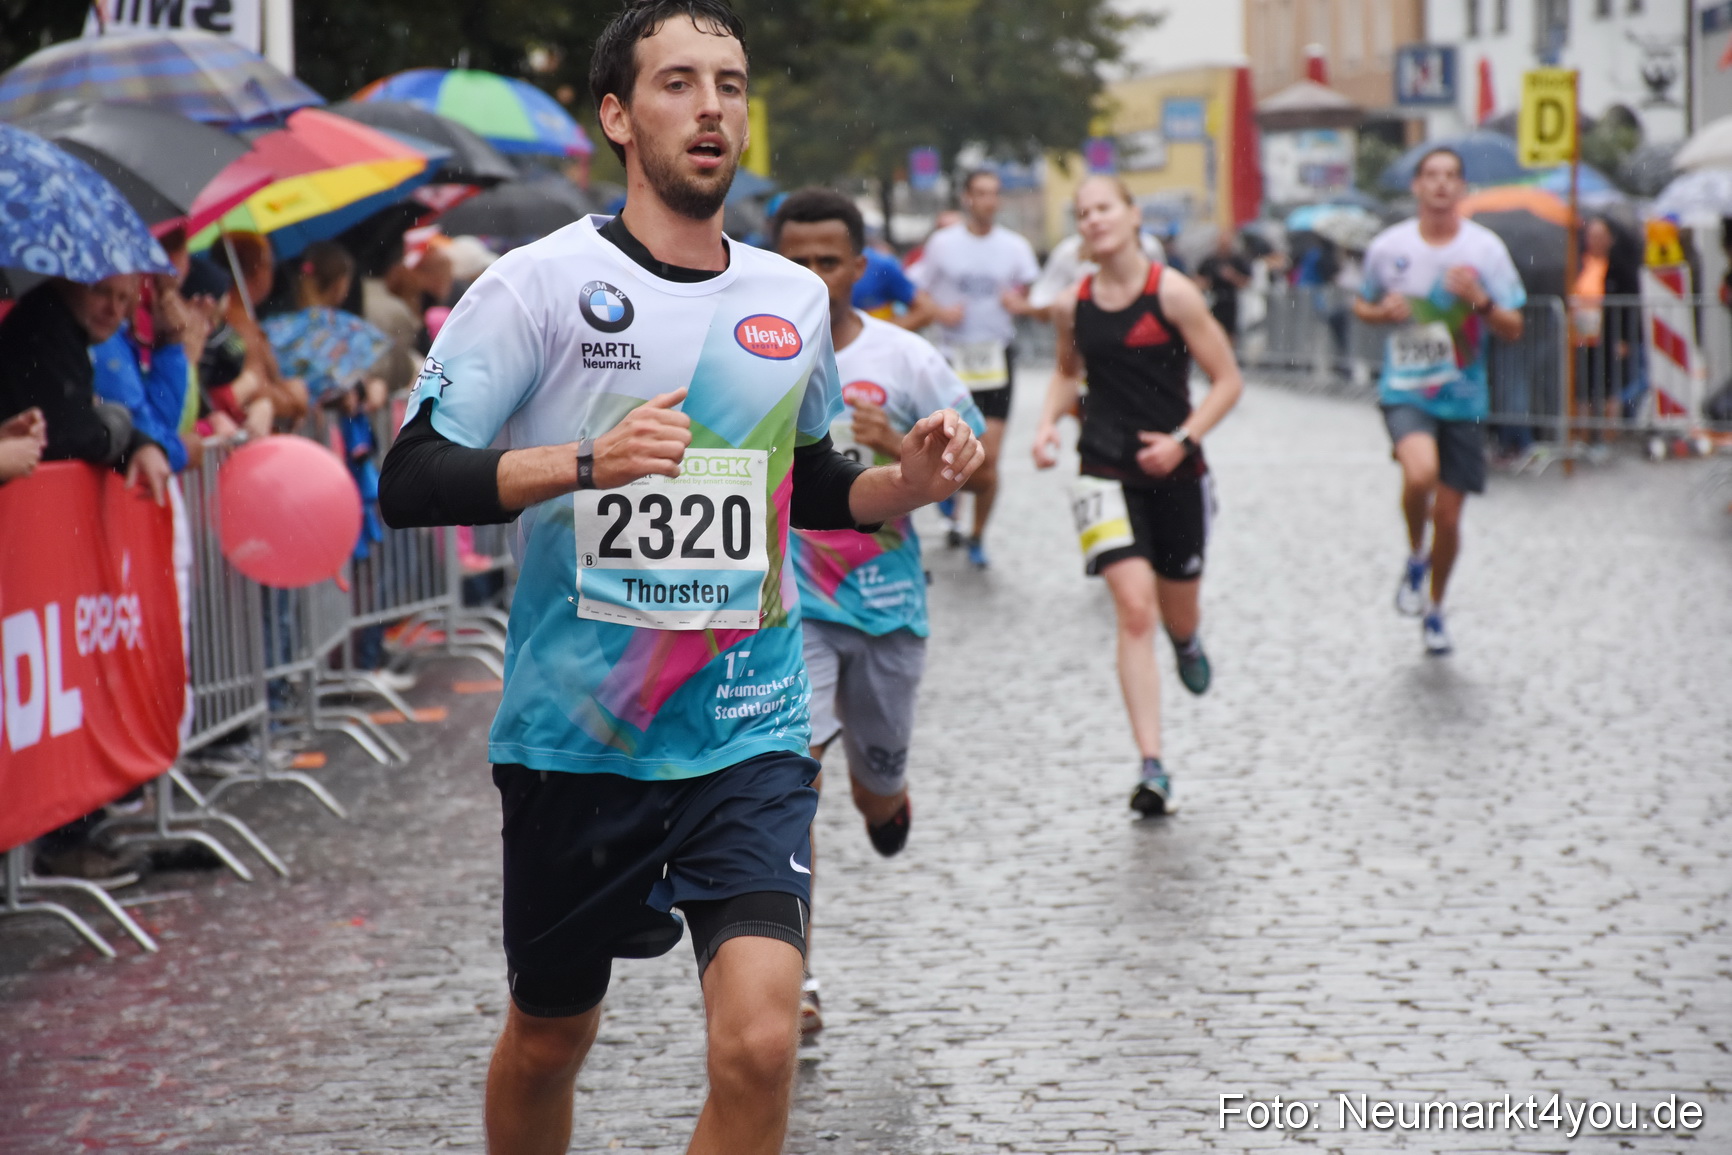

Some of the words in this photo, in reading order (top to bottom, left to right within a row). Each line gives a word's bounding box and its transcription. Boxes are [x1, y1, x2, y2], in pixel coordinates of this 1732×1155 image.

[1535, 97, 1564, 144] D
[582, 281, 626, 300] BMW
[744, 325, 797, 348] Hervis
[581, 342, 641, 359] PARTL
[583, 358, 641, 370] Neumarkt
[692, 478, 702, 486] by
[724, 479, 753, 487] concepts
[597, 493, 752, 560] 2320
[585, 554, 593, 567] B
[622, 578, 730, 605] Thorsten
[724, 650, 755, 680] 17.
[714, 694, 787, 720] Stadtlauf
